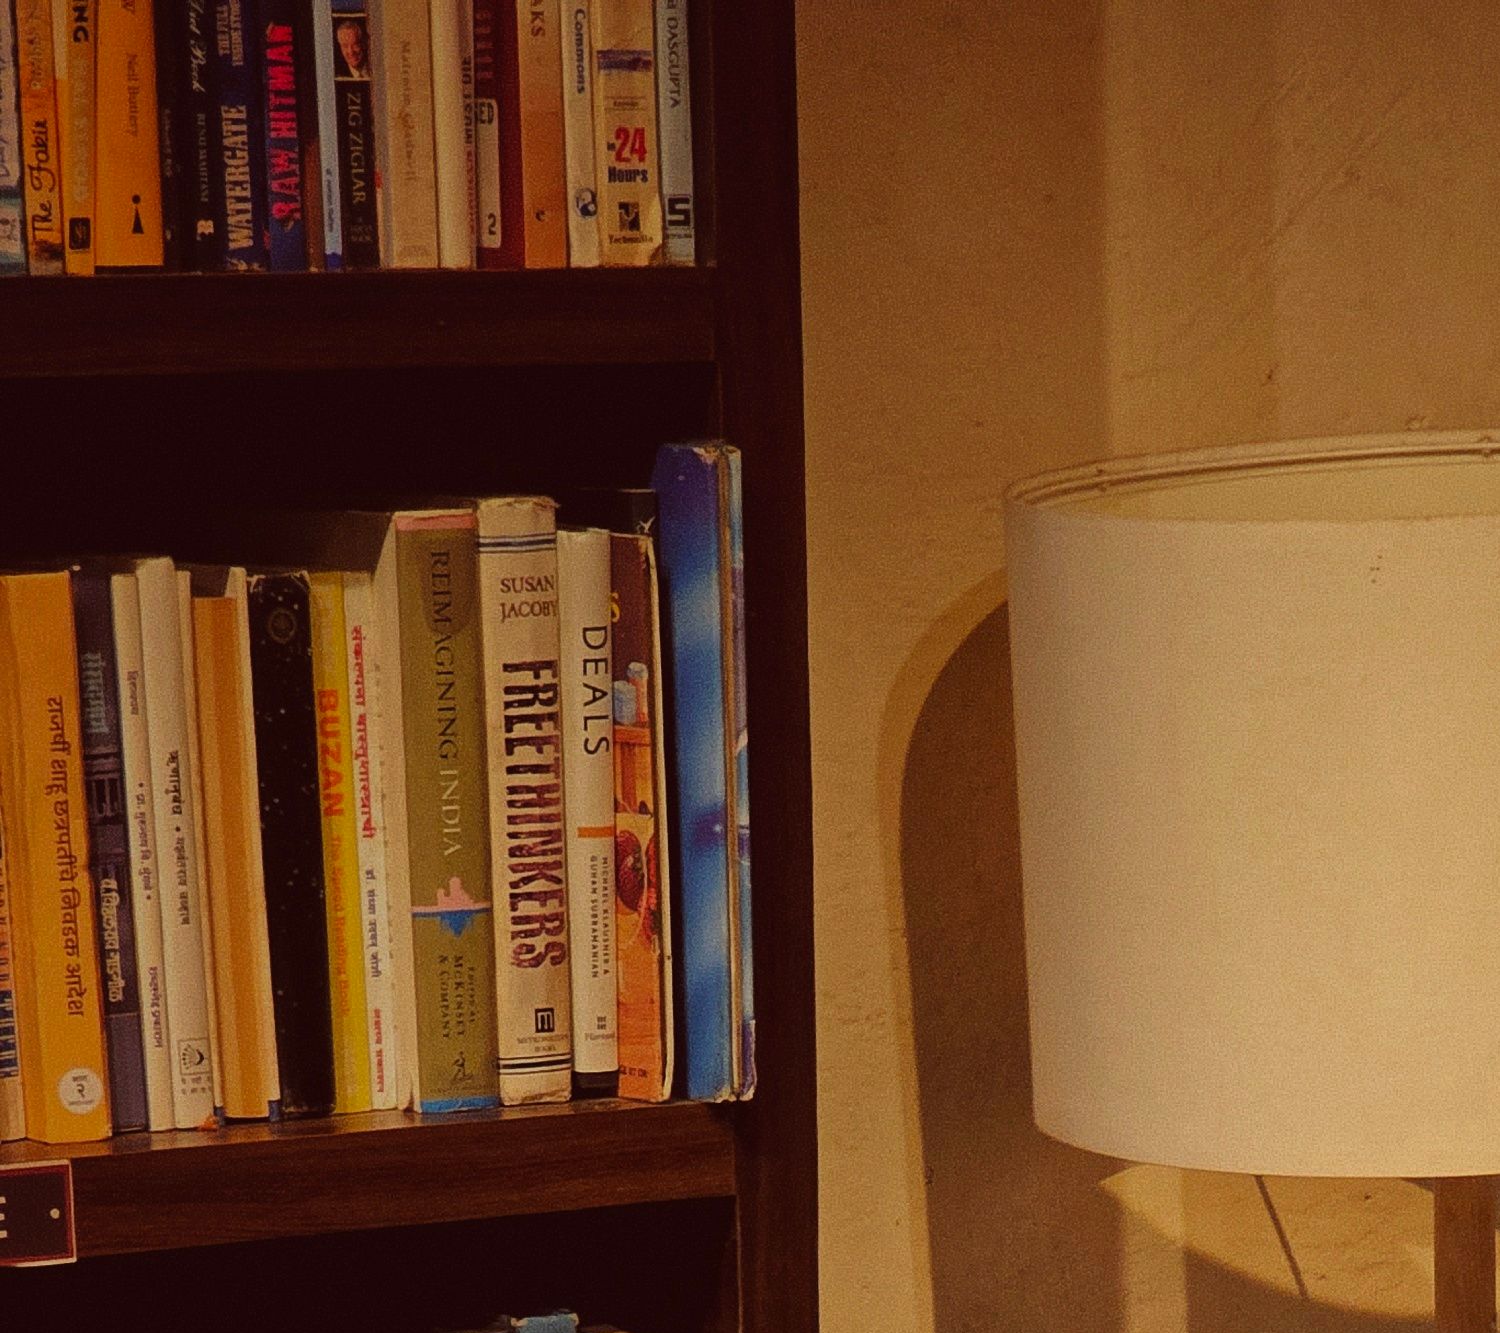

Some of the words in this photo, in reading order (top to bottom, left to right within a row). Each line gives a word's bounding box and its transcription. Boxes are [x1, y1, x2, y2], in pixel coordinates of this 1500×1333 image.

[573, 8, 588, 95] Commons
[666, 16, 681, 108] DASGUPTA
[347, 91, 363, 129] ZIG
[614, 126, 648, 163] 24
[220, 104, 254, 250] WATERGATE
[349, 132, 367, 206] ZIGLAR
[607, 167, 649, 184] Hours
[499, 577, 555, 595] SUSAN
[499, 600, 558, 621] JACOBY
[429, 551, 458, 760] REIMAGINING
[581, 624, 611, 756] DEALS
[316, 689, 344, 818] BUZAN
[439, 768, 463, 857] INDIA
[501, 659, 569, 970] FREETHINKERS
[65, 961, 88, 1018] आदेश
